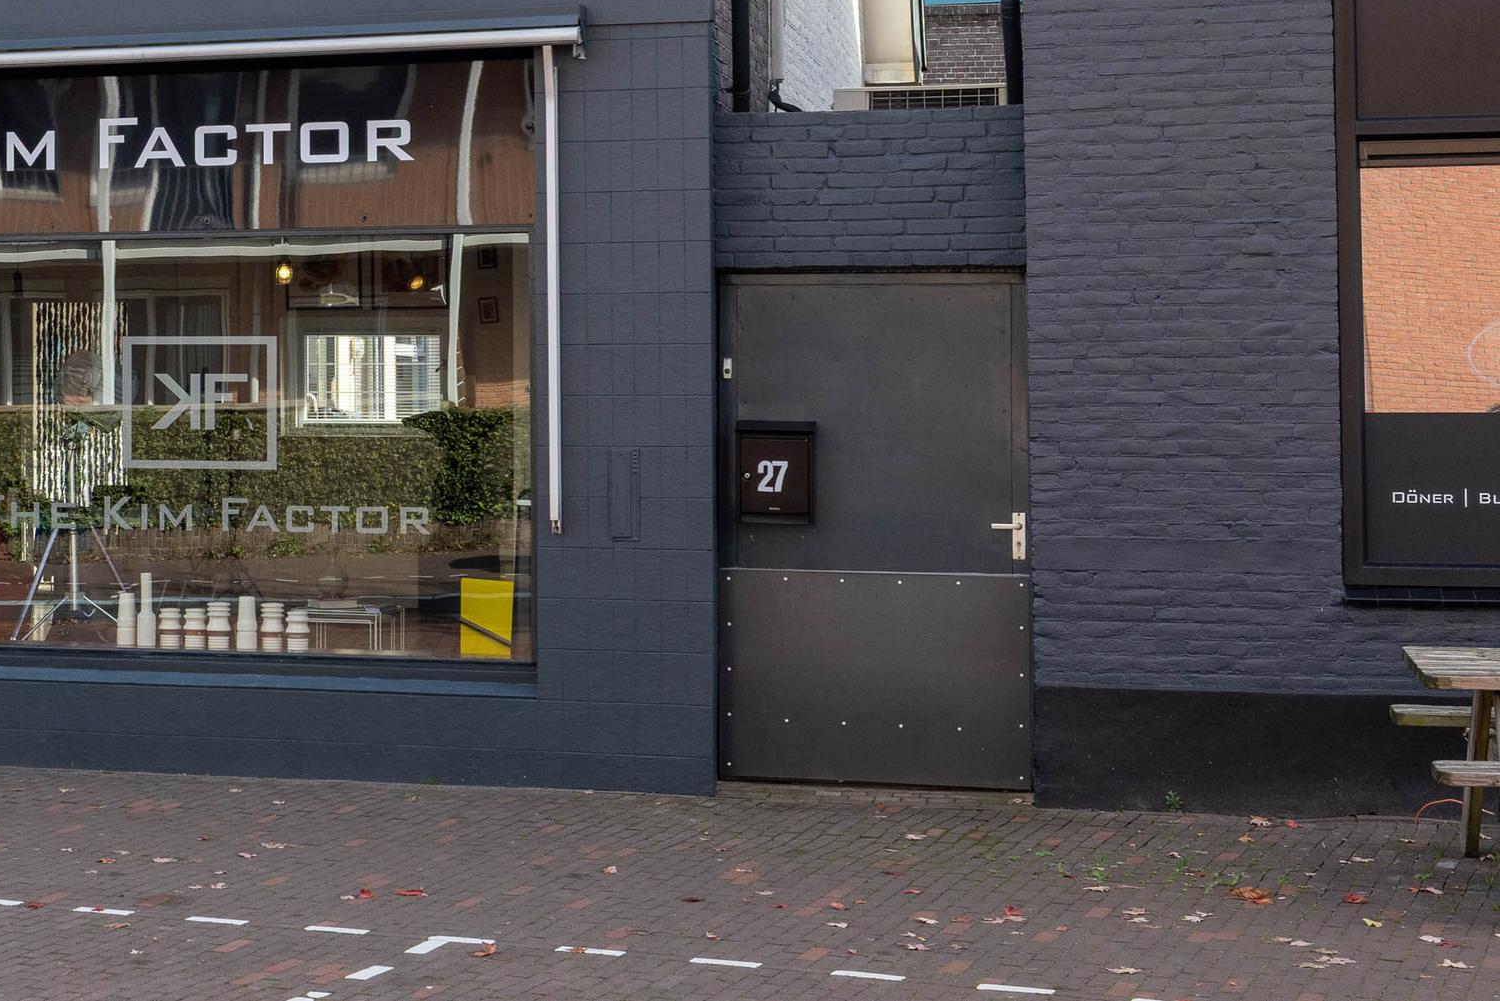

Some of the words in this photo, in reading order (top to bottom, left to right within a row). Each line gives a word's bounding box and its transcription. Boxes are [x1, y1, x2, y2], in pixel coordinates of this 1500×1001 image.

[99, 117, 415, 170] FACTOR
[757, 460, 789, 493] 27
[1392, 489, 1454, 504] DÖNER
[103, 495, 193, 532] KIM
[221, 497, 432, 535] FACTOR
